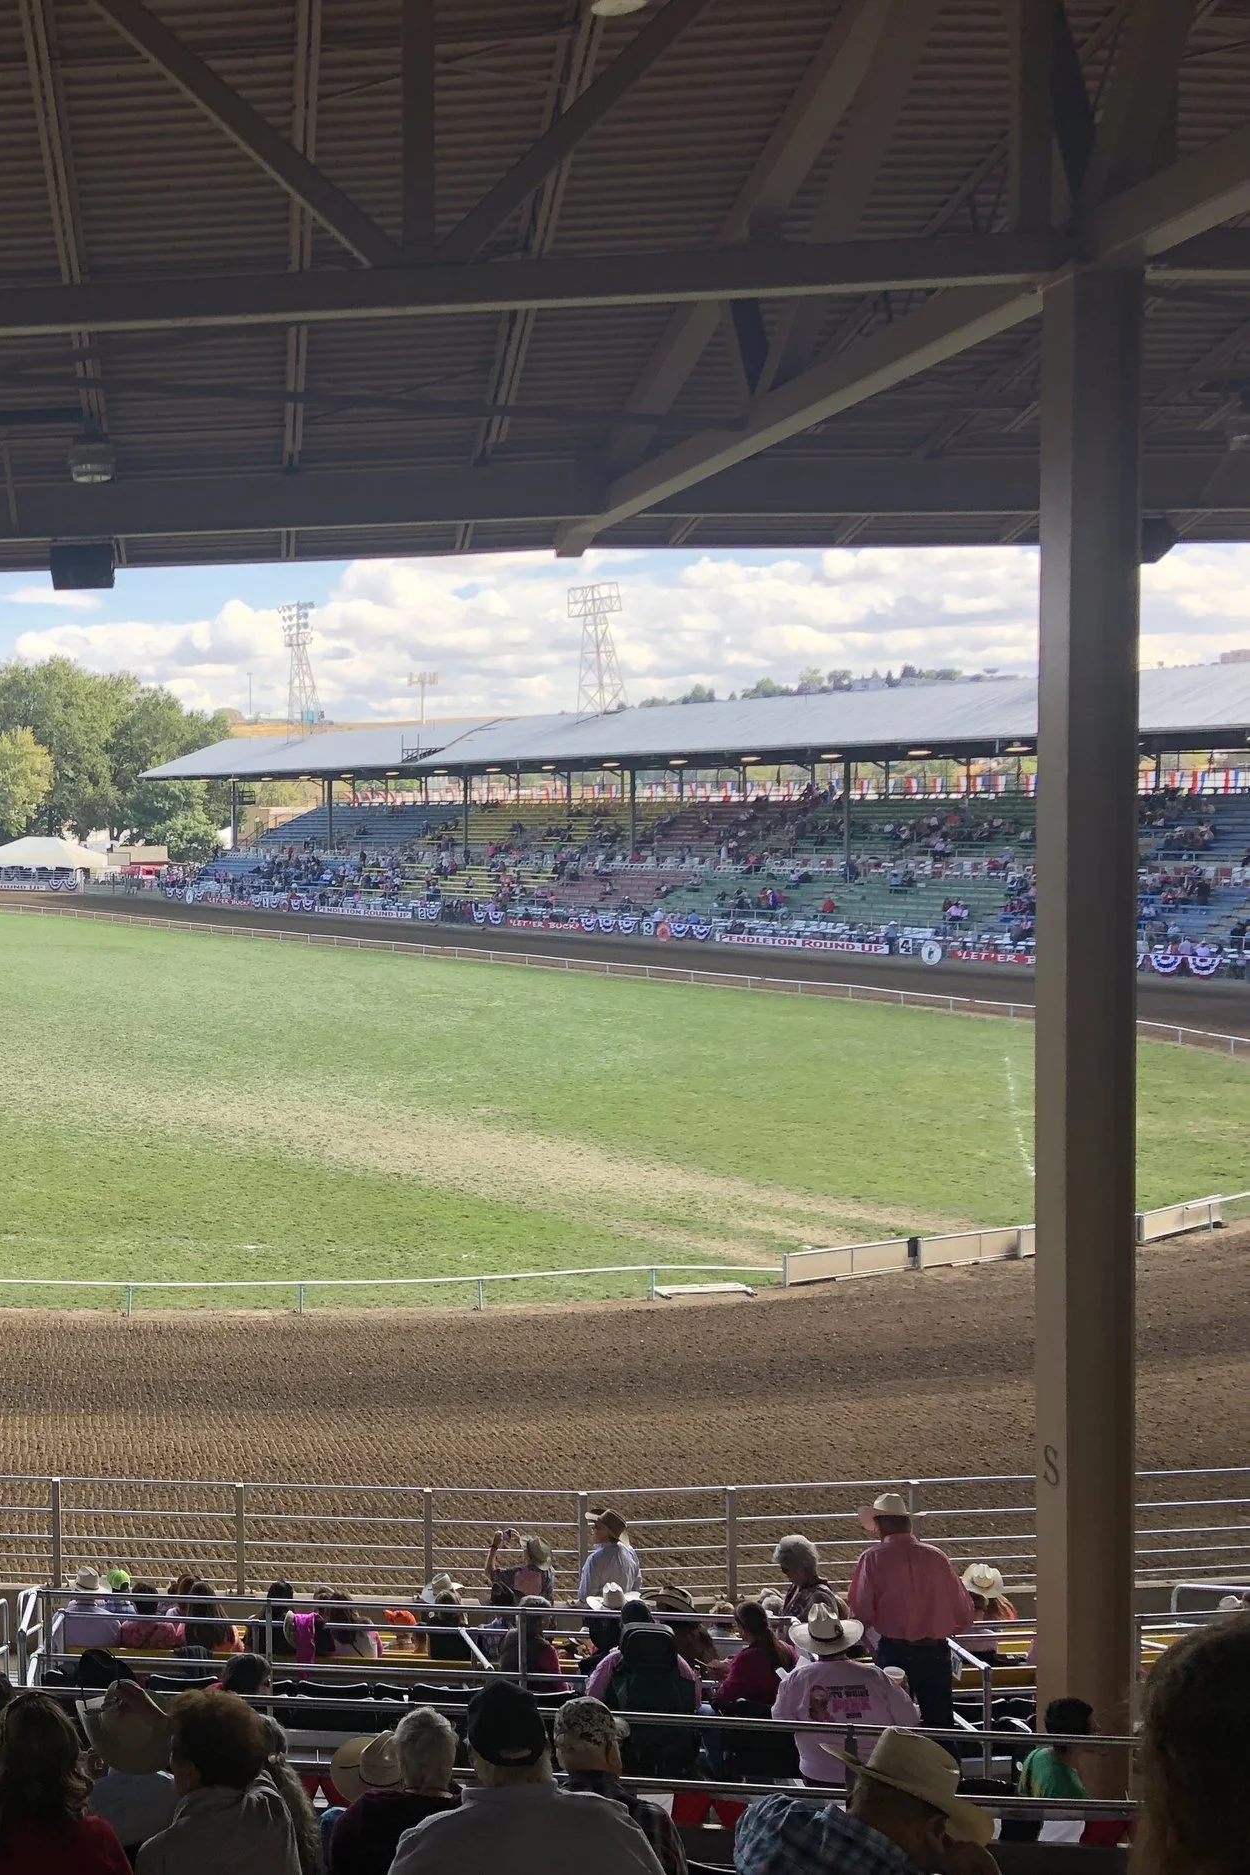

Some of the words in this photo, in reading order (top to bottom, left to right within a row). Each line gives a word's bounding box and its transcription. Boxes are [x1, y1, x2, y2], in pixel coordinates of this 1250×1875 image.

[318, 906, 361, 915] PENDLETON
[363, 910, 410, 918] ROUND-UP
[419, 908, 426, 918] 2
[643, 922, 653, 934] 3
[720, 934, 797, 946] PENDLETON
[802, 939, 885, 953] ROUND-UP
[900, 939, 911, 952] 4
